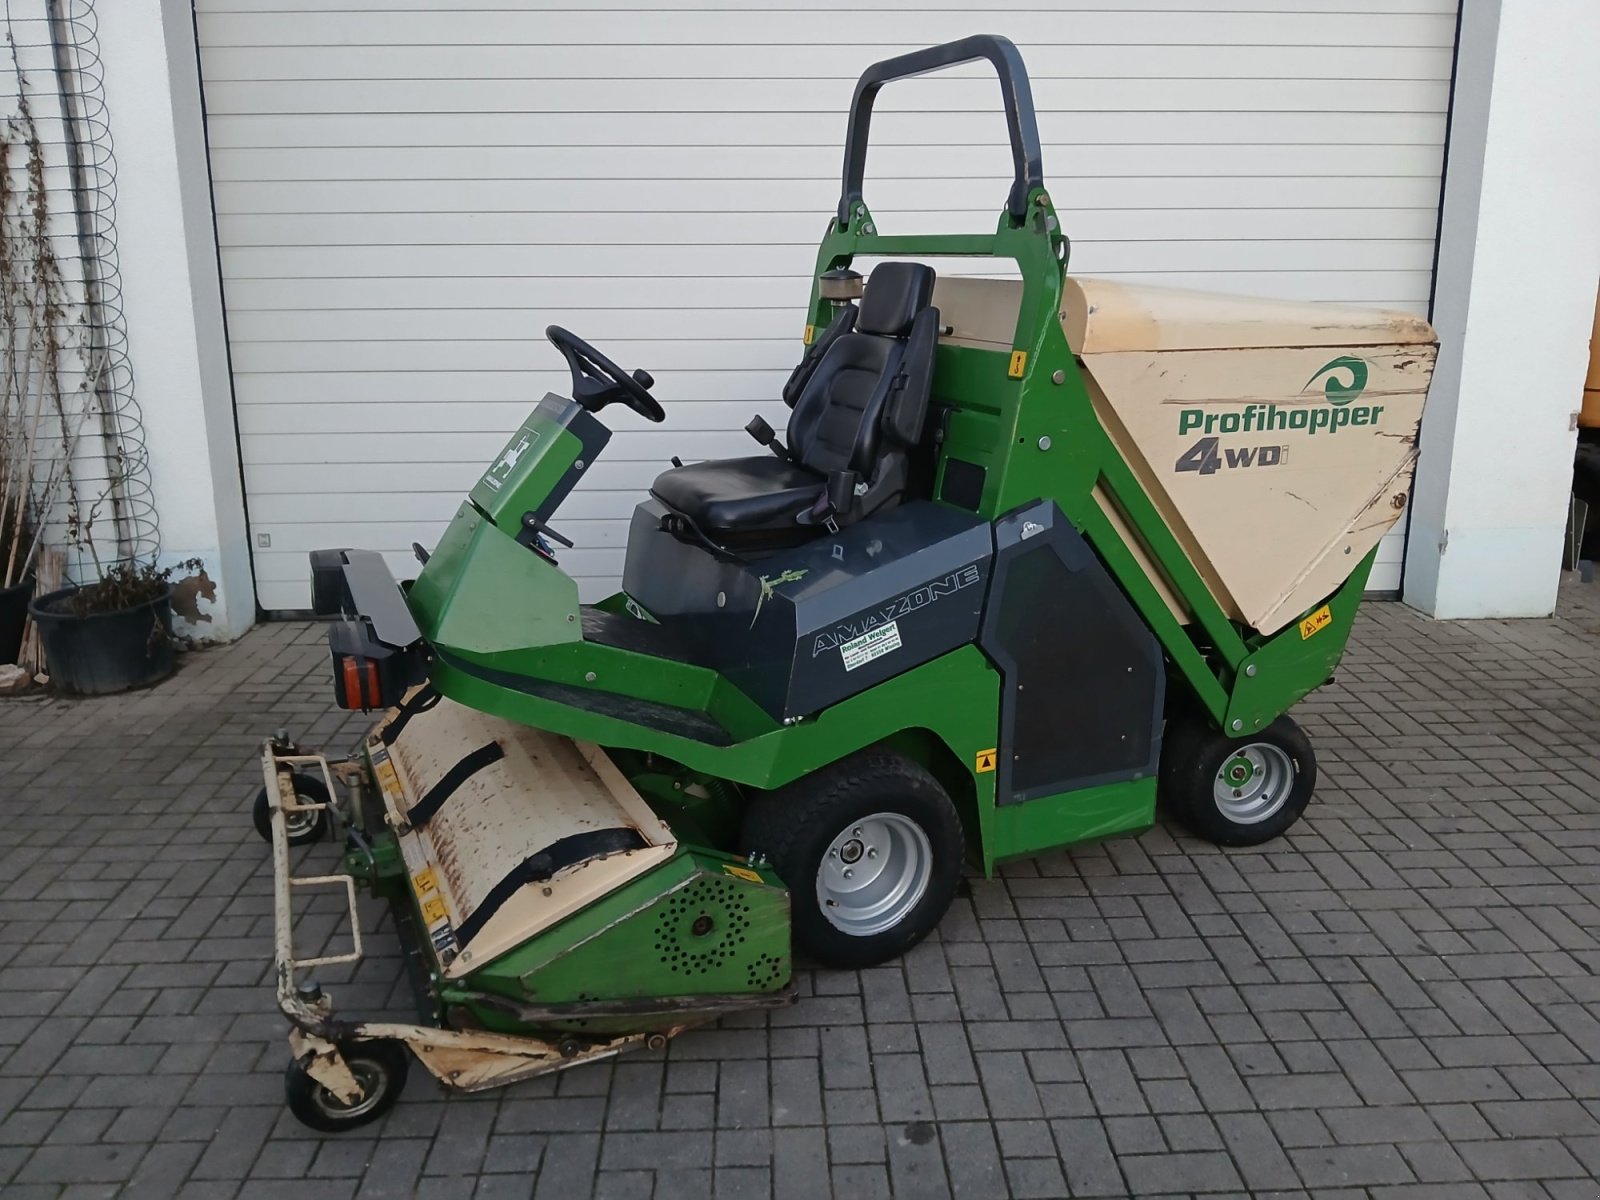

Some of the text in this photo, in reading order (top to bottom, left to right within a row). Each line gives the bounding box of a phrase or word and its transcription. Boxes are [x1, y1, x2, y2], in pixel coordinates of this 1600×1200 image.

[1178, 404, 1384, 436] Profihopper
[812, 564, 980, 659] AMAZONE
[841, 636, 867, 653] Roland
